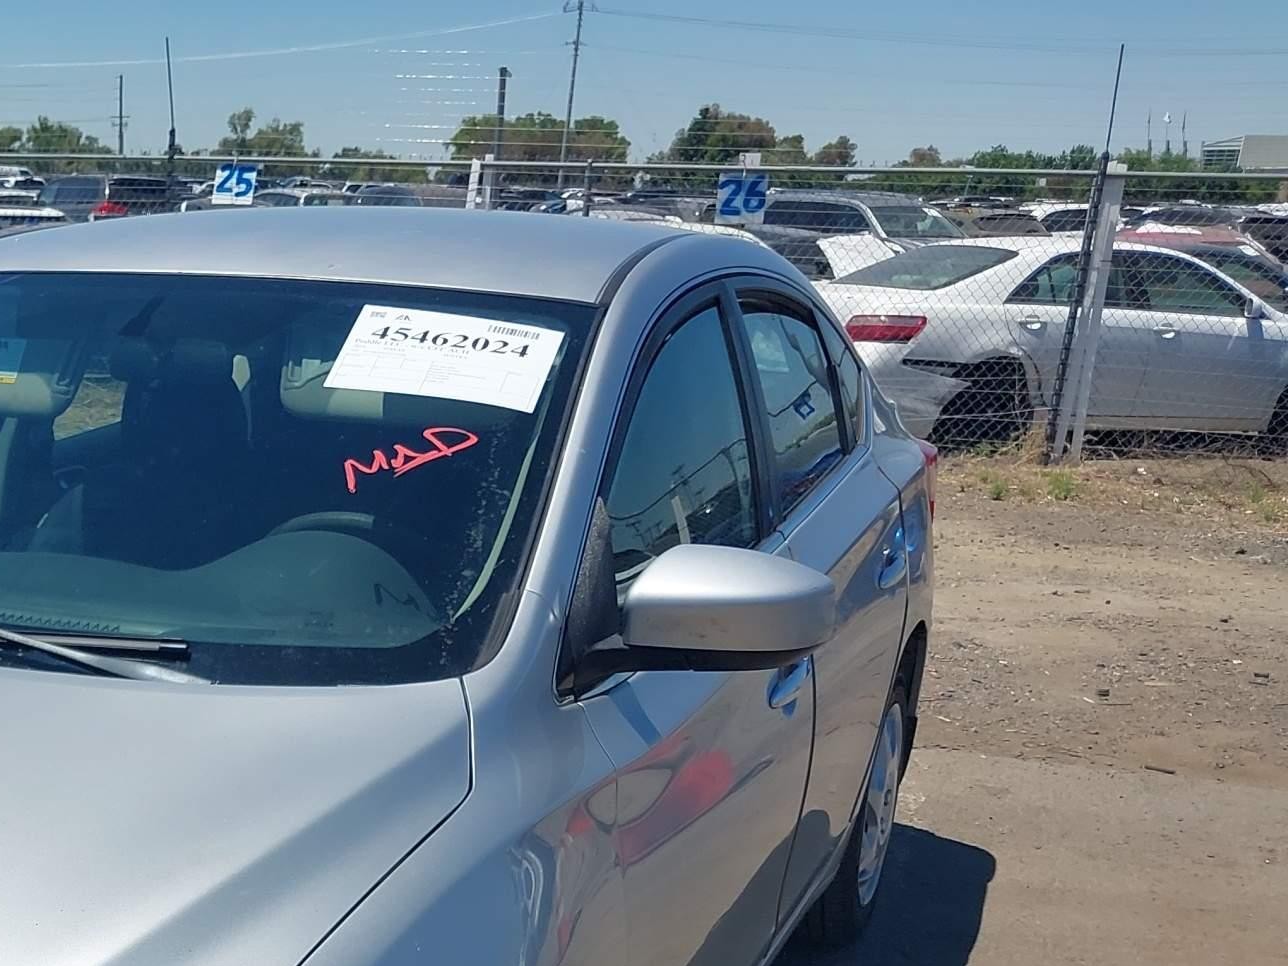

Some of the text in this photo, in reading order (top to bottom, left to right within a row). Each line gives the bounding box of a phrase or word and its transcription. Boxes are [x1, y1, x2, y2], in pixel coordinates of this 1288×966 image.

[215, 163, 257, 198] 25
[718, 174, 767, 216] 26
[370, 325, 530, 358] 45462024
